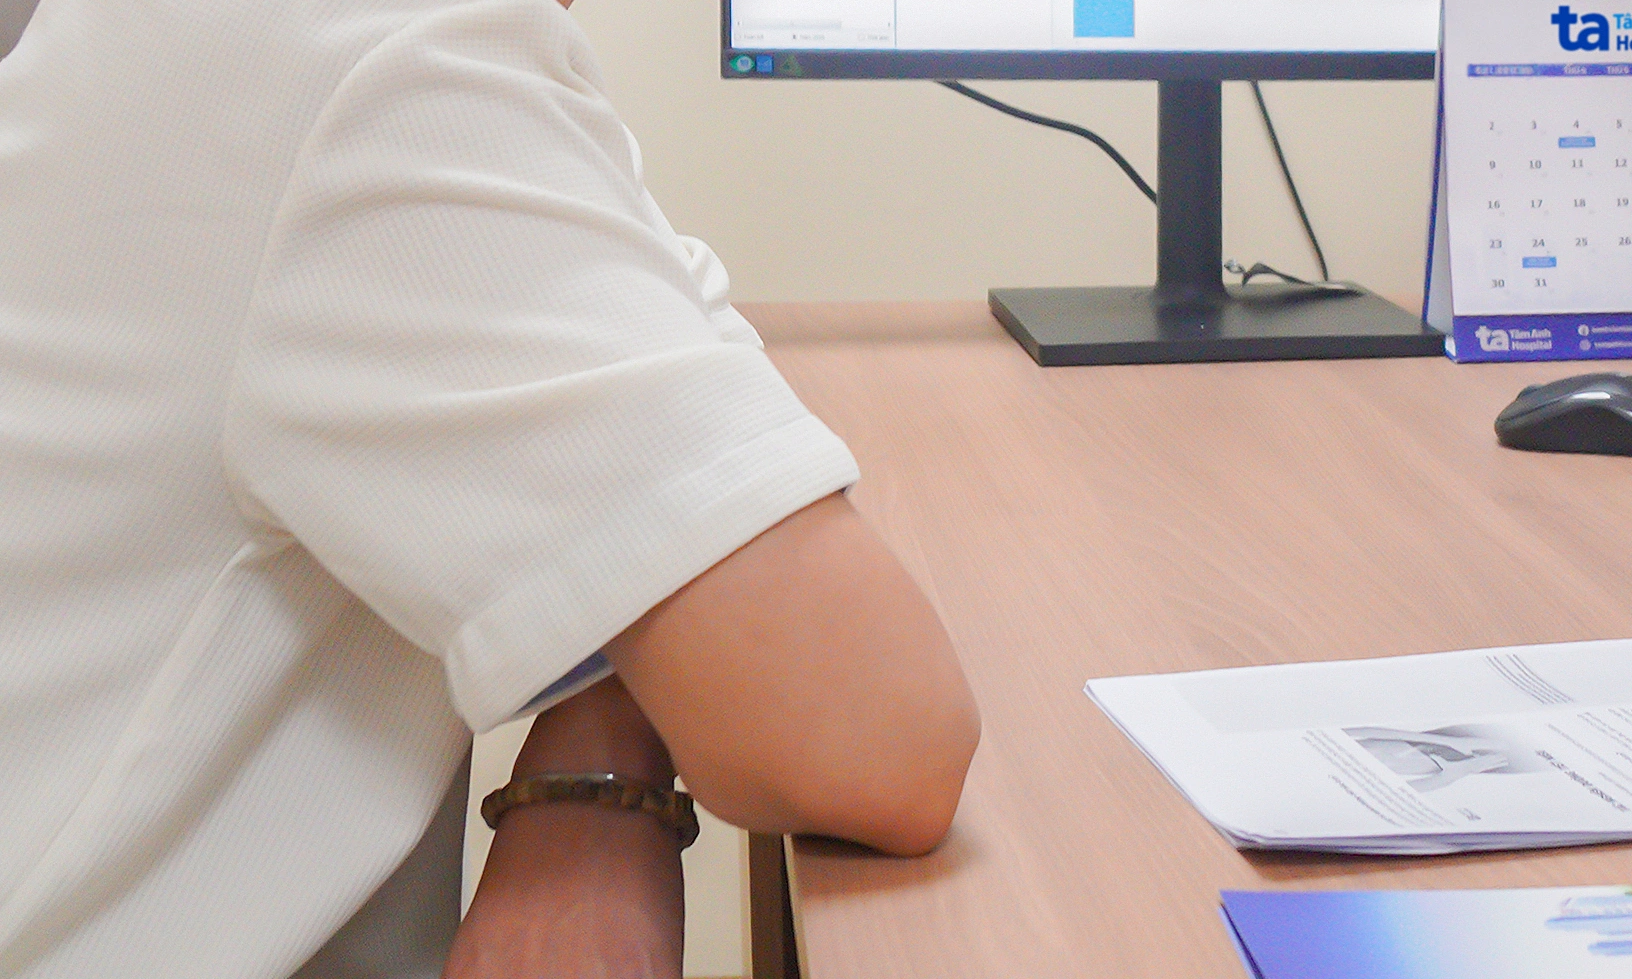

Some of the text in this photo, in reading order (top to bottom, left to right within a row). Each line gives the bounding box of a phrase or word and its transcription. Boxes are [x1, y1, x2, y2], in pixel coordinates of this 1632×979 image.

[1551, 5, 1610, 51] ta
[1573, 120, 1580, 129] 4
[1529, 159, 1542, 170] 10
[1571, 159, 1584, 169] 11
[1615, 158, 1628, 168] 12
[1487, 200, 1501, 210] 16
[1530, 199, 1543, 209] 17
[1573, 198, 1587, 208] 18
[1616, 197, 1630, 207] 19
[1532, 238, 1546, 248] 24
[1575, 237, 1589, 247] 25
[1618, 236, 1632, 246] 26
[1492, 279, 1506, 288] 30
[1511, 340, 1552, 352] Hospital
